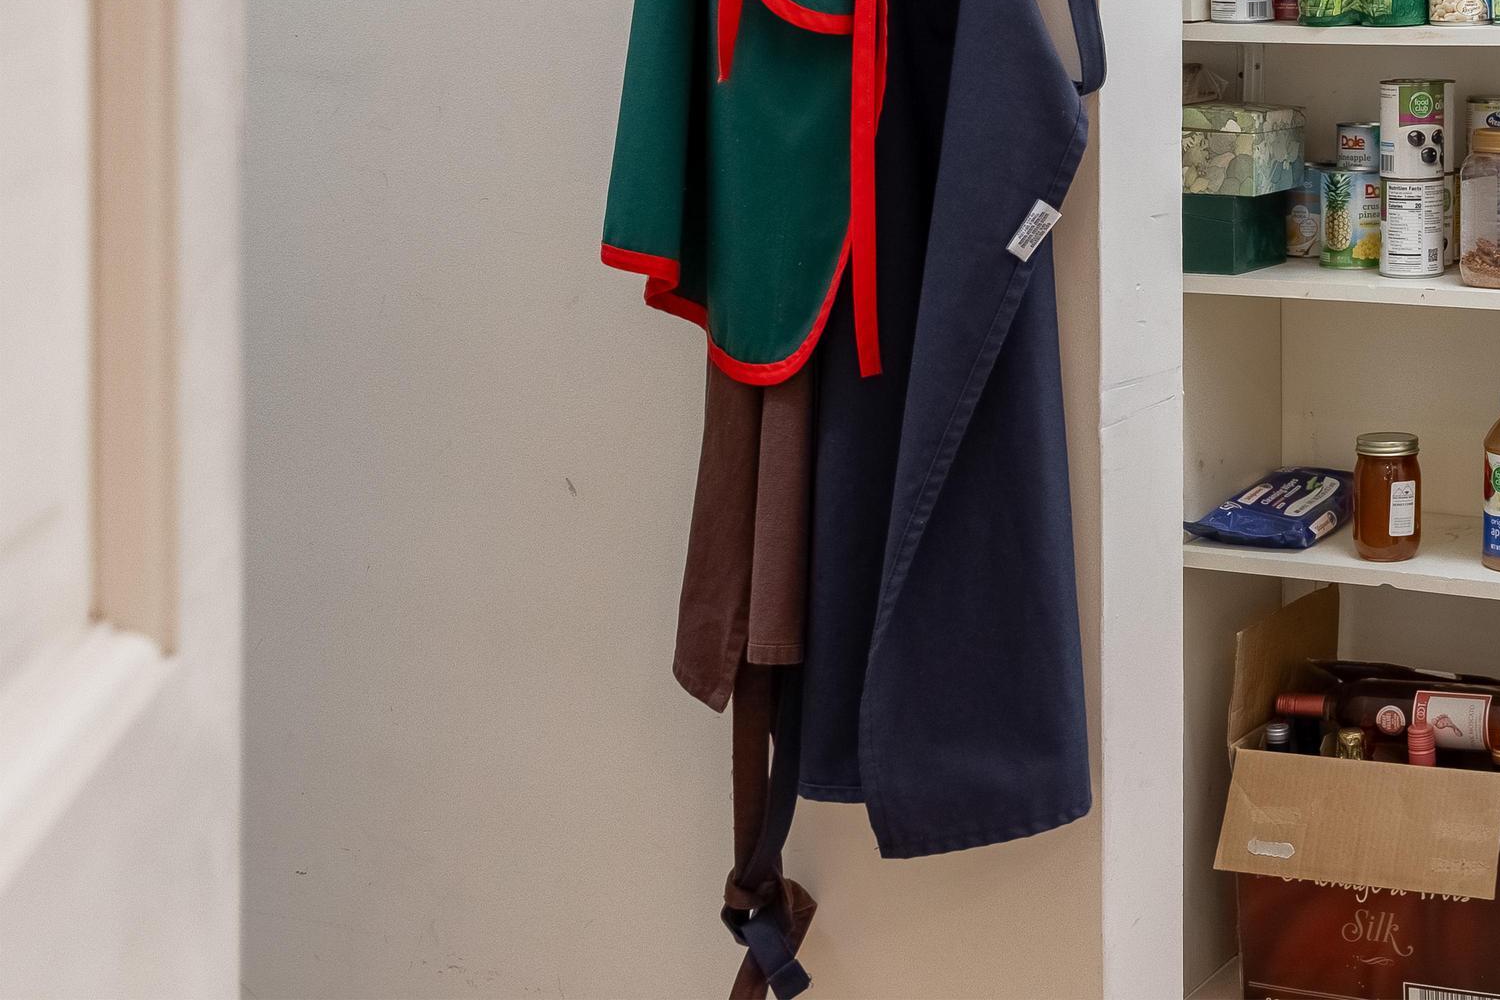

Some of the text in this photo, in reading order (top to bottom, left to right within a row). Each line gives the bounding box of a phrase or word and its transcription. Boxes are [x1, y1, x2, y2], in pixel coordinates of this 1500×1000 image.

[1414, 104, 1429, 112] club
[1342, 136, 1366, 147] Dole
[1341, 908, 1414, 957] Silk
